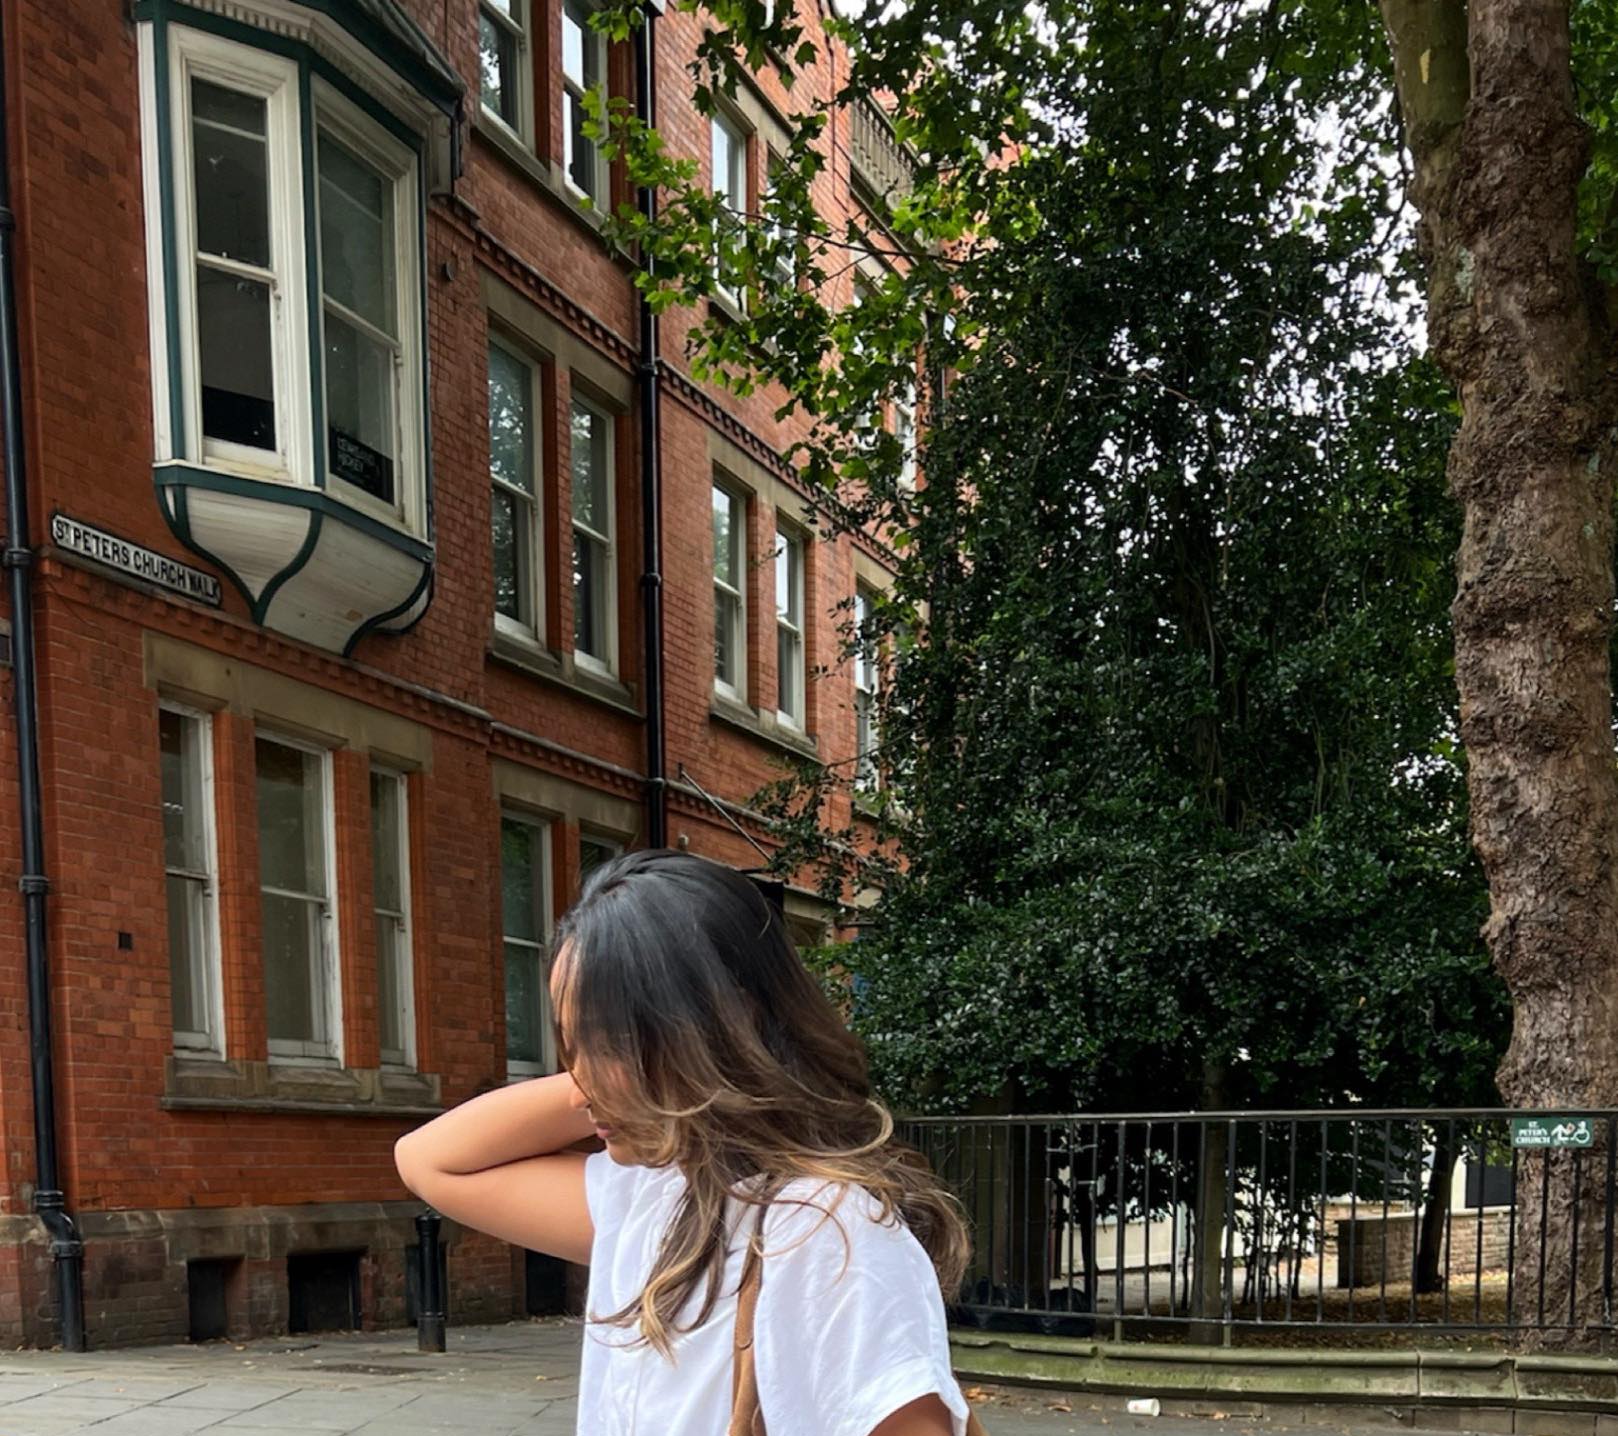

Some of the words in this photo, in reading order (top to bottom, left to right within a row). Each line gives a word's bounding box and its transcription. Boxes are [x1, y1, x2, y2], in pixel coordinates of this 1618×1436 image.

[72, 527, 130, 567] PETERS
[132, 550, 186, 588] CHURCH
[187, 570, 219, 599] WALK
[1515, 1136, 1551, 1145] CHURCH
